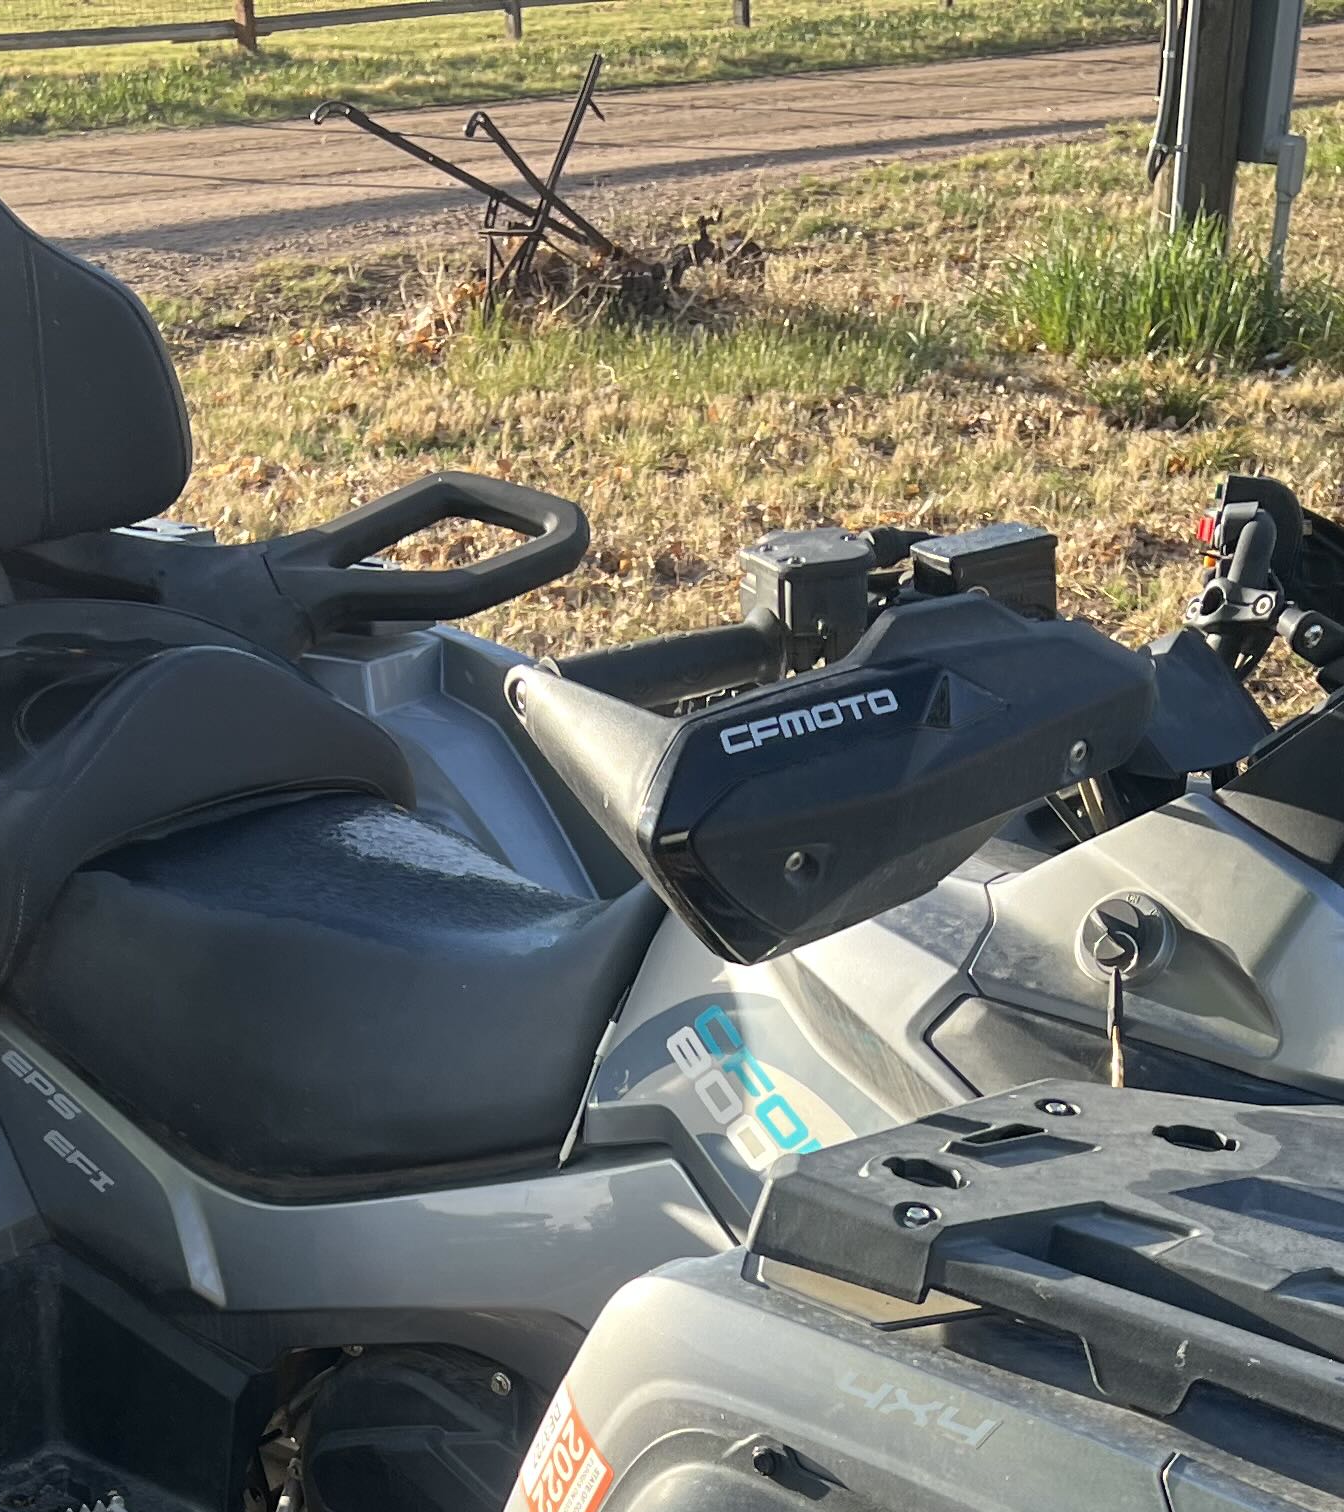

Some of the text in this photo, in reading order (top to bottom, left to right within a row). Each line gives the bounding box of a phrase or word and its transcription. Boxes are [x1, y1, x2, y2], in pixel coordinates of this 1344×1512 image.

[719, 688, 898, 756] CFMOTO
[0, 1049, 83, 1120] EPS
[694, 1004, 822, 1155] CFO
[43, 1129, 115, 1193] EFI
[584, 1466, 600, 1495] STATE
